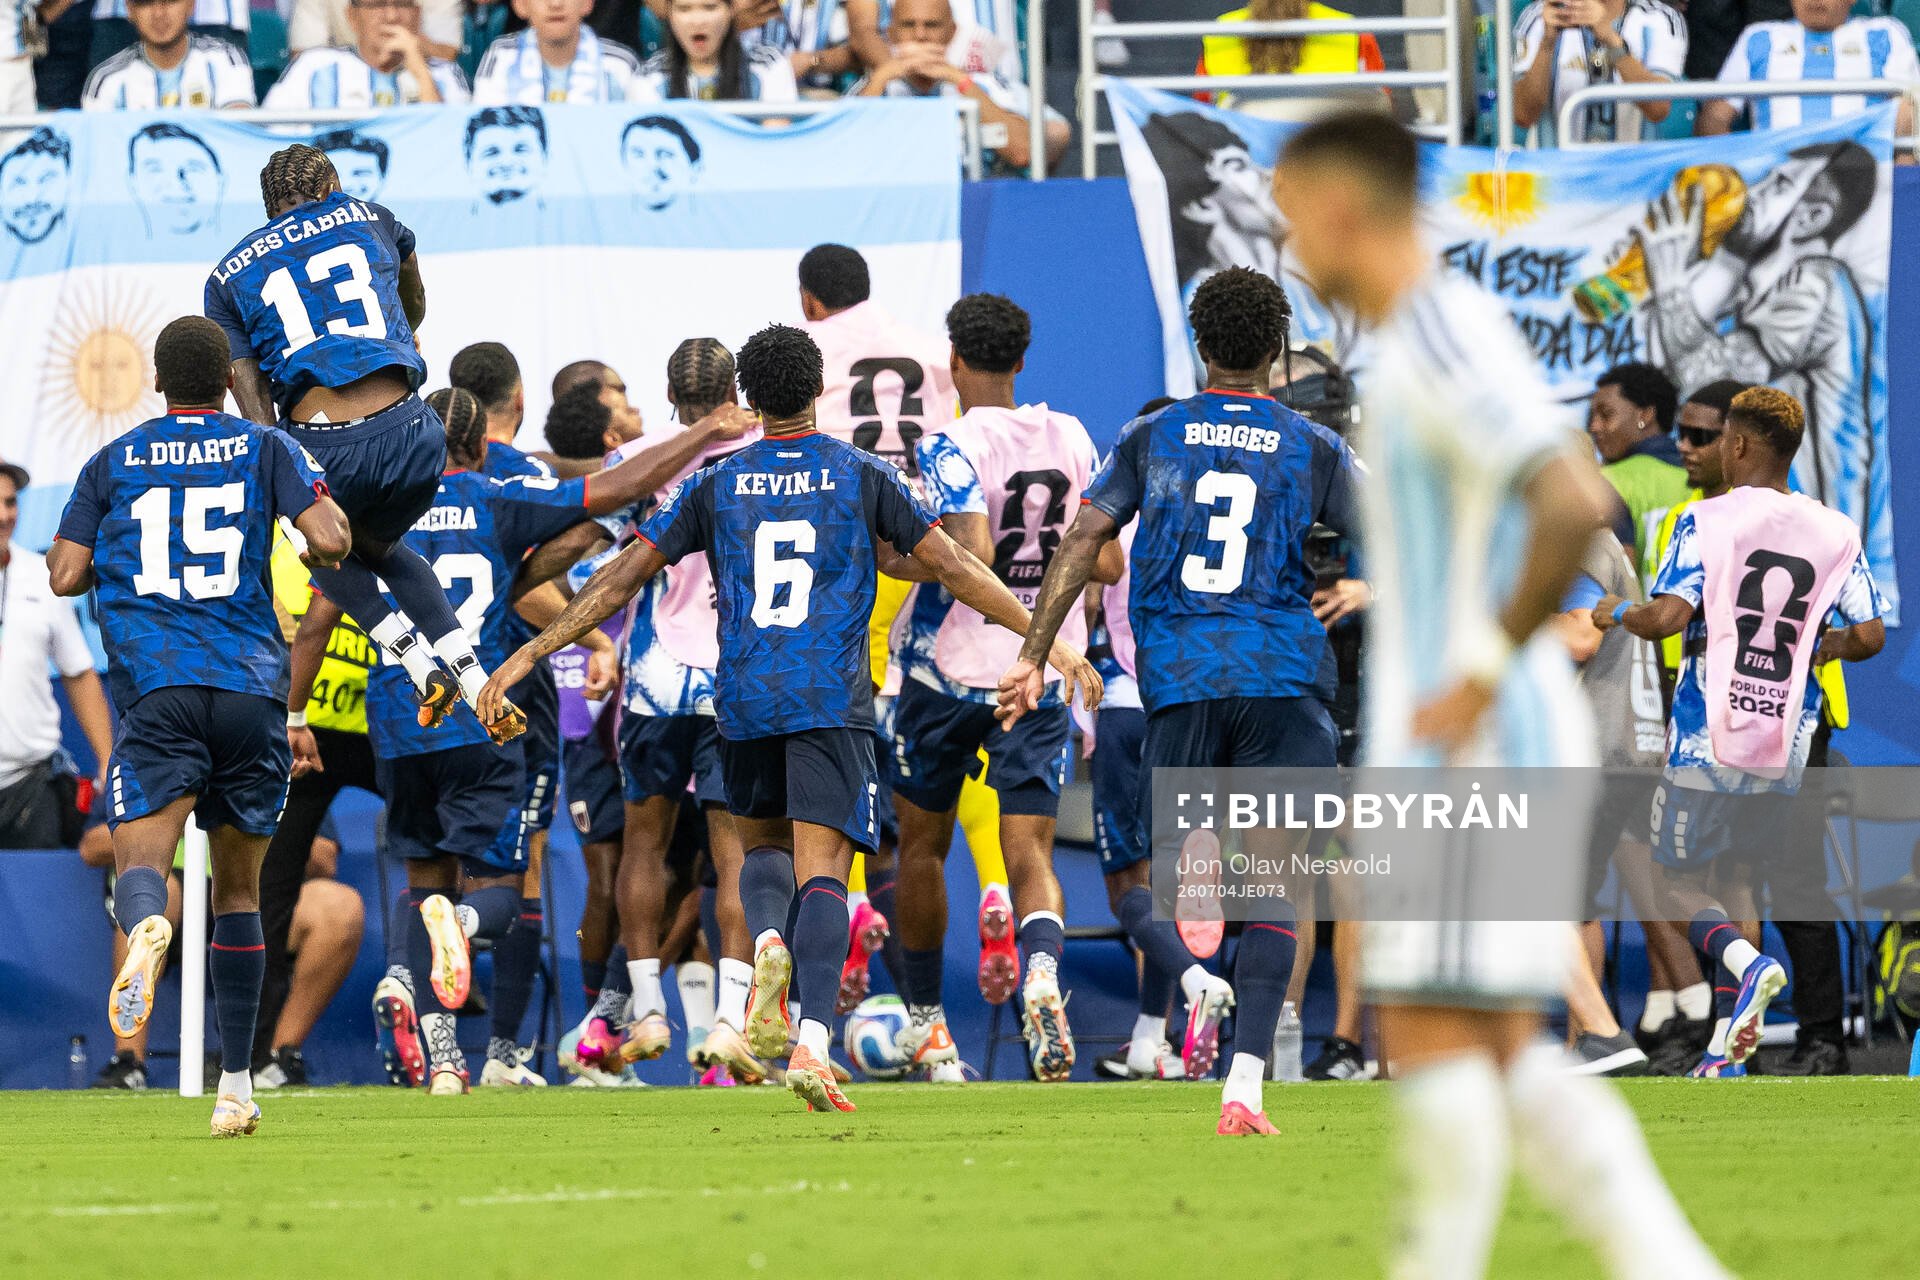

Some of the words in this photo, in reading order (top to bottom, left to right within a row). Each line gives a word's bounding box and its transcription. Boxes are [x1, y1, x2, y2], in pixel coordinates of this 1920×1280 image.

[212, 231, 284, 286] LOPES
[283, 201, 379, 243] CABRAL
[260, 243, 387, 360] 13
[150, 434, 249, 466] DUARTE
[1184, 421, 1281, 454] BORGES
[734, 470, 816, 496] KEVIN.
[820, 468, 836, 491] L
[131, 481, 246, 601] 15
[750, 519, 817, 629] 6
[1180, 469, 1258, 594] 3
[1743, 651, 1776, 672] FIFA
